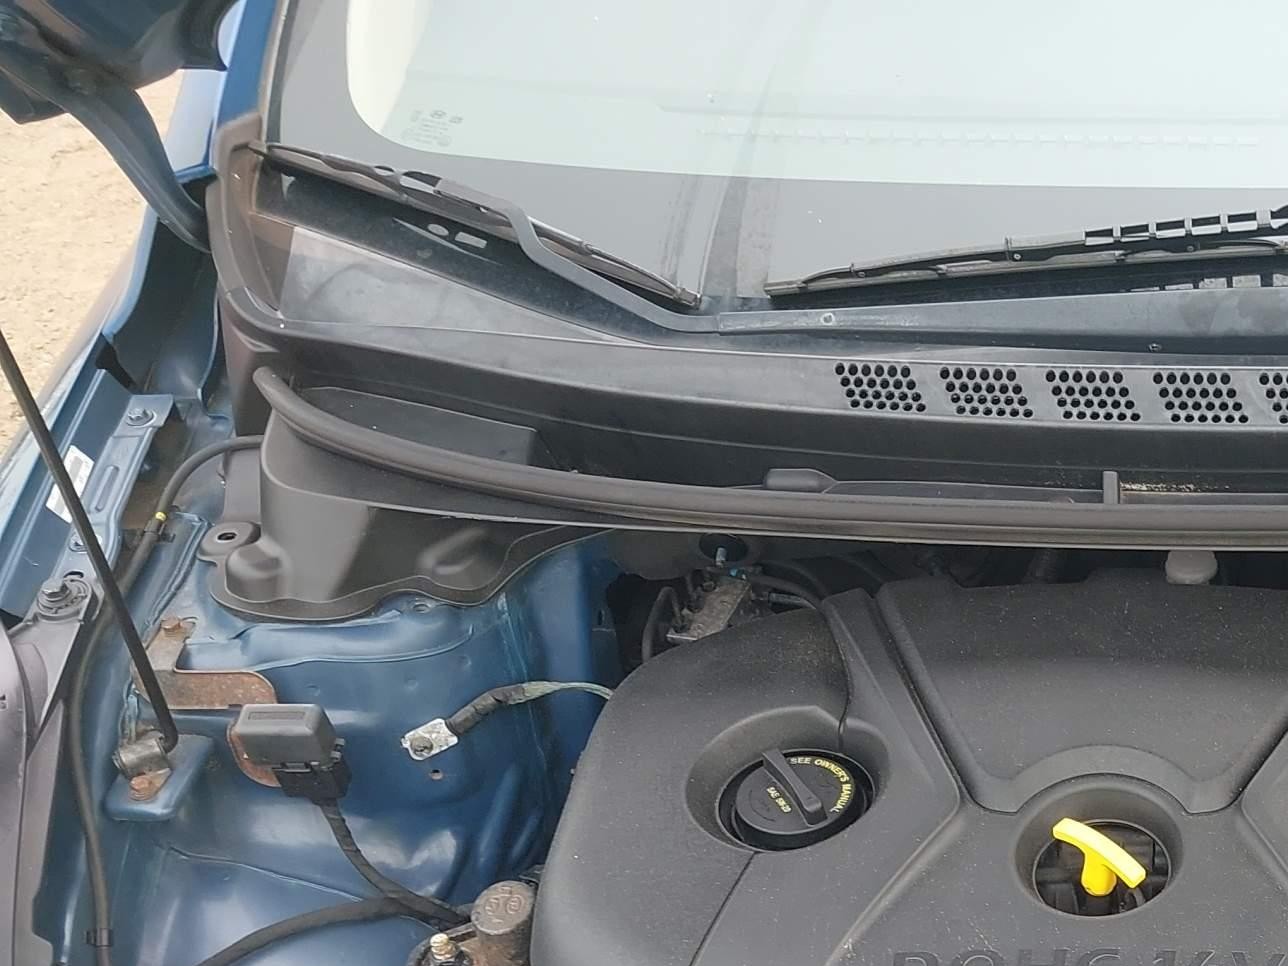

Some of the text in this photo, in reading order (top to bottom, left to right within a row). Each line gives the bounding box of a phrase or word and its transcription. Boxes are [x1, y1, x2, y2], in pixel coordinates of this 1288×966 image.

[790, 756, 852, 812] SEE OWNER'S MANUAL
